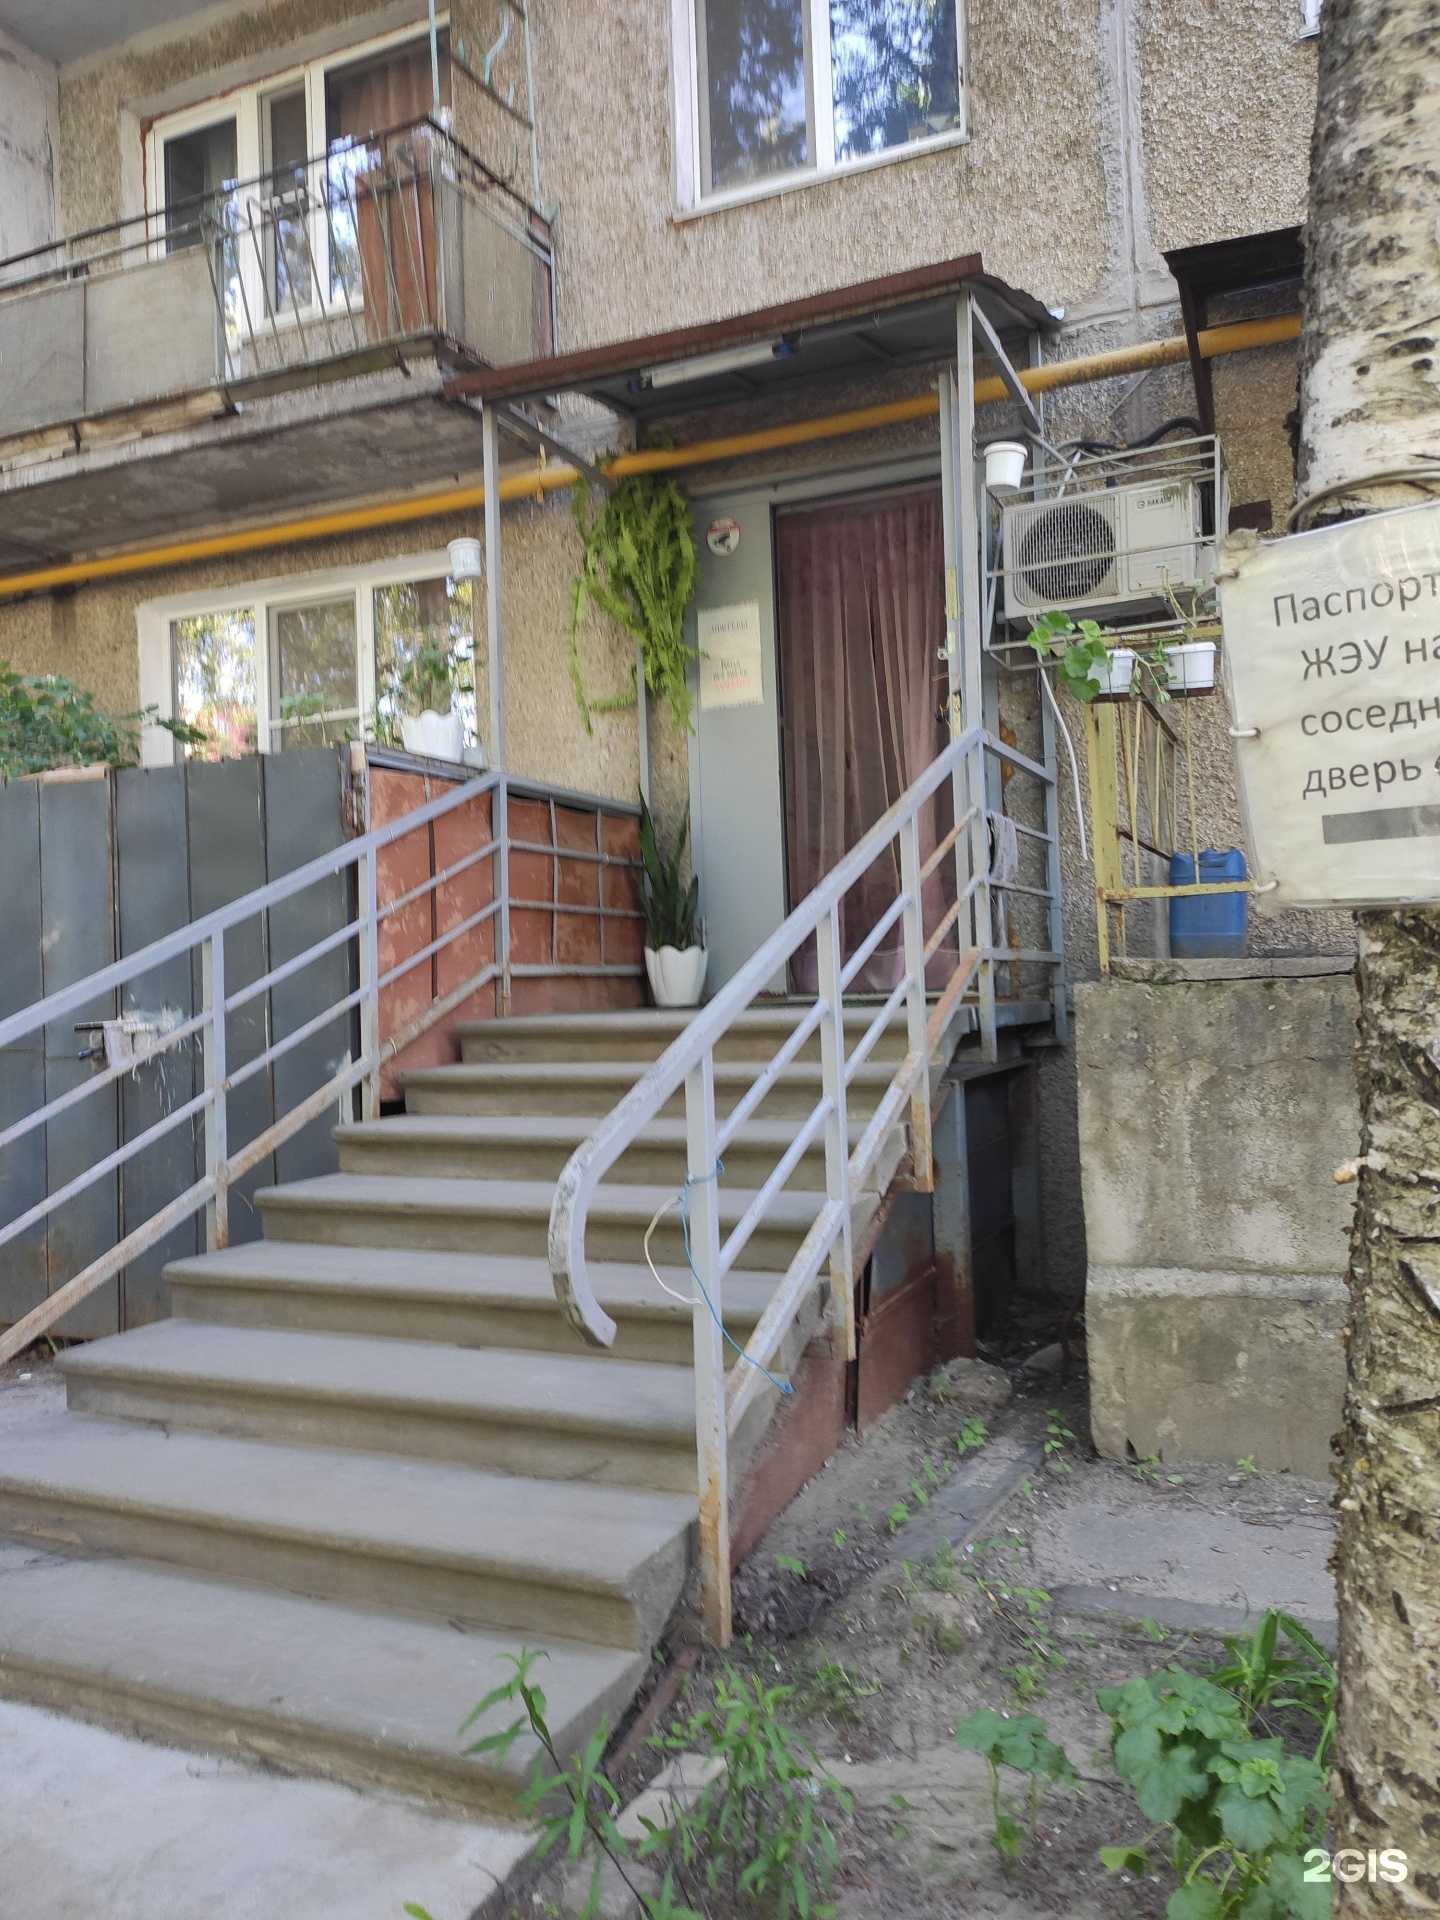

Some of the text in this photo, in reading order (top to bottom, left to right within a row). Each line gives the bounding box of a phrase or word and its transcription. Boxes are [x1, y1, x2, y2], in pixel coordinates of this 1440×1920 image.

[1273, 573, 1440, 627] Паспорт
[1301, 635, 1388, 681] ЖЭУ
[1301, 696, 1440, 736] соседн
[1303, 758, 1421, 801] дверь
